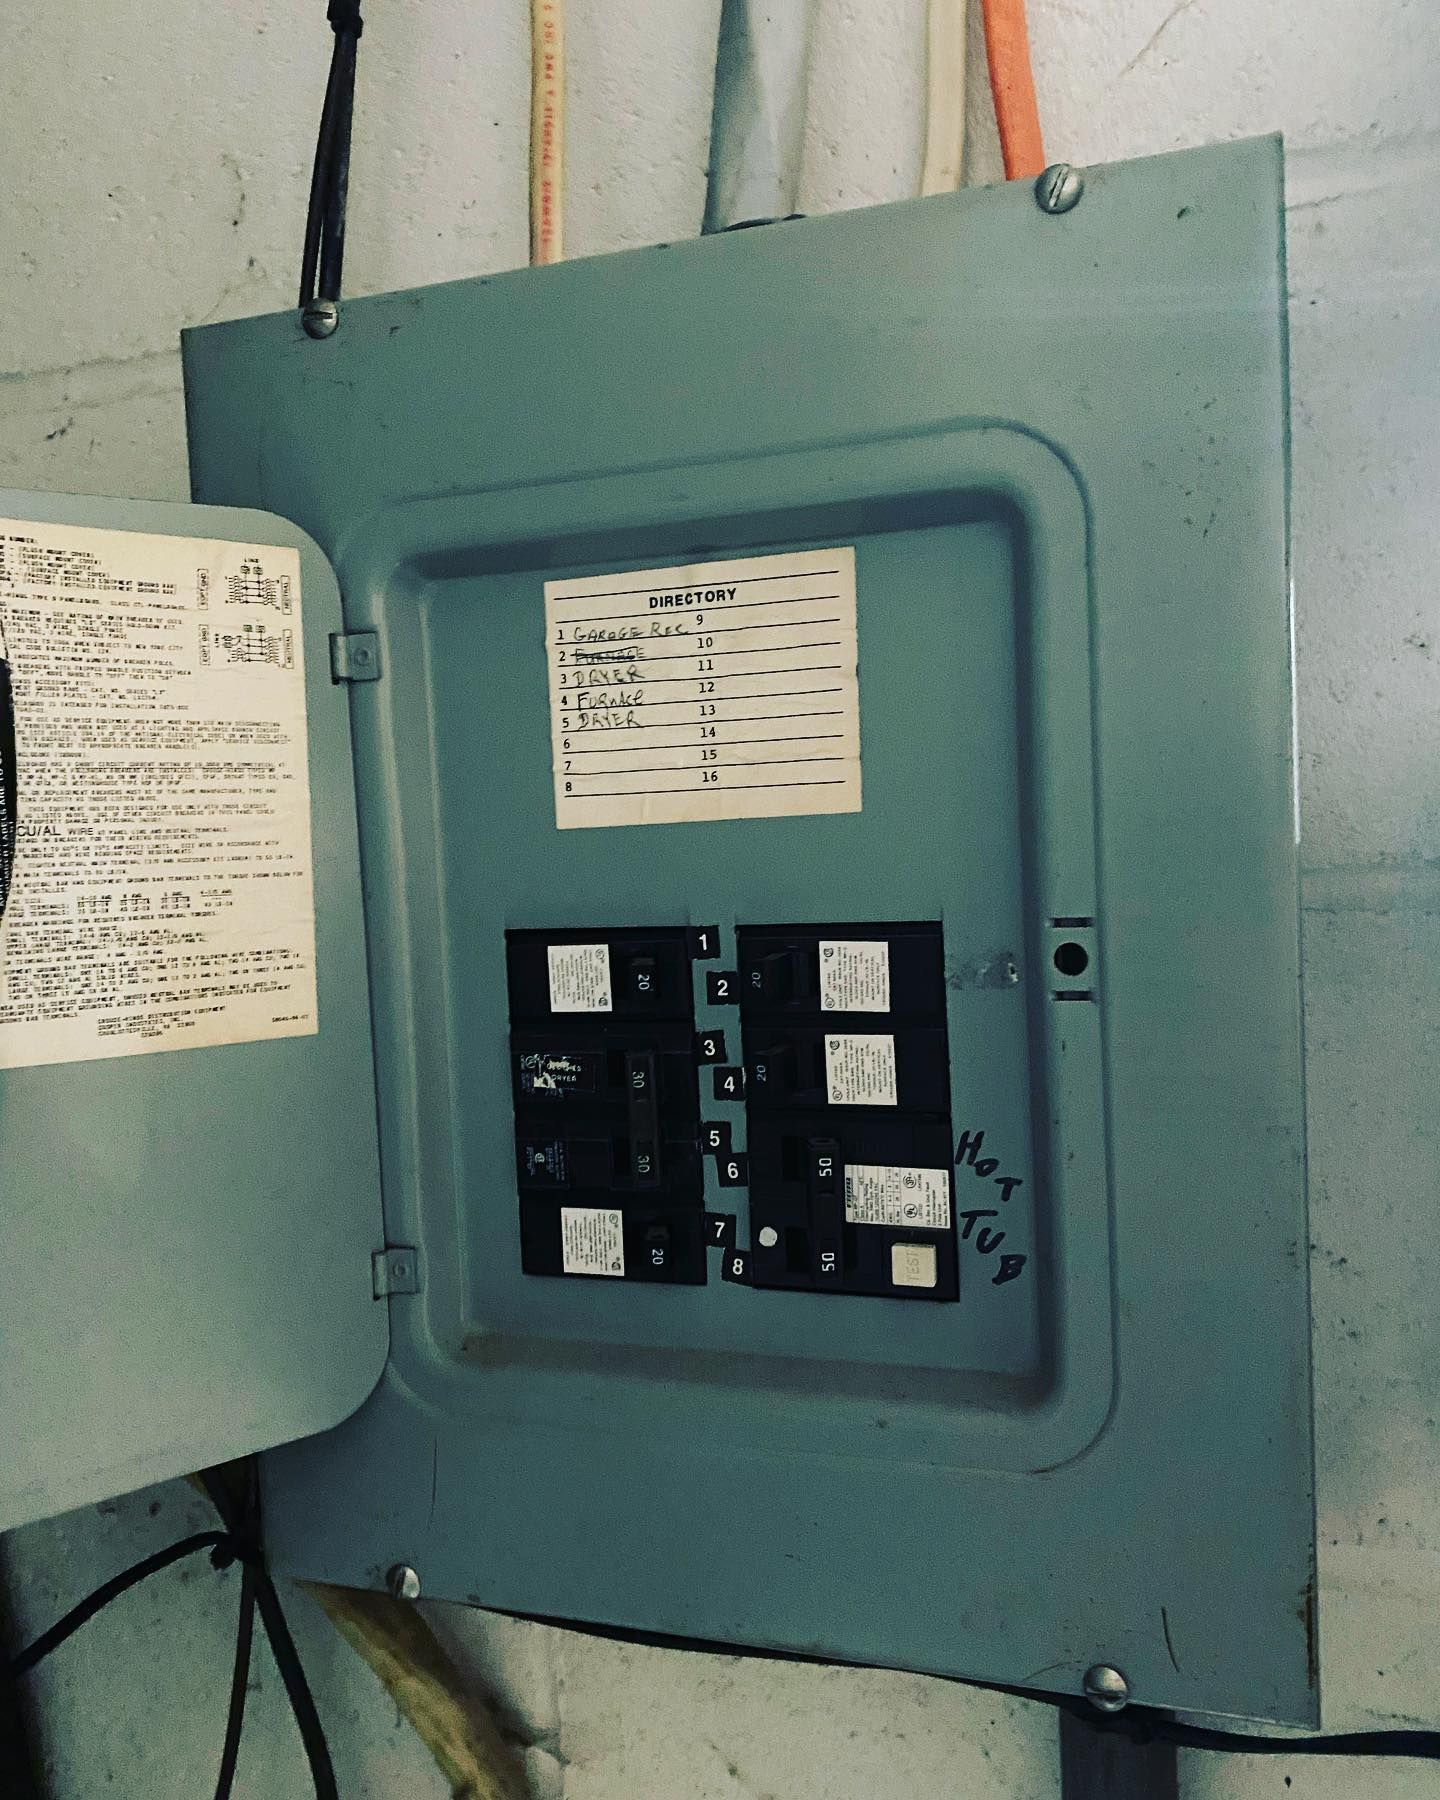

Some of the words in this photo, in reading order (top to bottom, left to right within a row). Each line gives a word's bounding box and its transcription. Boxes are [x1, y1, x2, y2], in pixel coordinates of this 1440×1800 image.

[649, 587, 737, 609] DIRECTORY
[696, 614, 704, 625] 9
[557, 629, 563, 640] 1
[697, 637, 713, 649] 10
[559, 651, 566, 662] 2
[698, 659, 714, 671] 11
[560, 673, 567, 684] 3
[699, 682, 715, 693] 12
[561, 695, 568, 706] 4
[699, 705, 716, 716] 13
[562, 717, 569, 728] 5
[700, 726, 716, 738] 14
[563, 739, 570, 749] 6
[701, 749, 718, 761] 15
[564, 761, 572, 771] 7
[702, 771, 718, 783] 16
[565, 782, 572, 792] 8
[16, 825, 61, 836] CU/AL
[67, 827, 94, 835] WIRE
[699, 933, 708, 951] 1
[638, 973, 651, 990] 20
[717, 979, 729, 996] 2
[752, 971, 761, 989] 20
[703, 1039, 716, 1056] 3
[632, 1071, 644, 1089] 30
[756, 1064, 766, 1082] 20
[724, 1076, 735, 1093] 4
[709, 1130, 720, 1147] 5
[637, 1154, 650, 1173] 30
[727, 1162, 739, 1179] 6
[818, 1157, 832, 1177] 50
[955, 1130, 1023, 1201] HOT
[715, 1221, 725, 1238] 7
[651, 1248, 664, 1265] 20
[960, 1210, 1027, 1286] TUB
[732, 1258, 744, 1275] 8
[821, 1252, 835, 1272] 50
